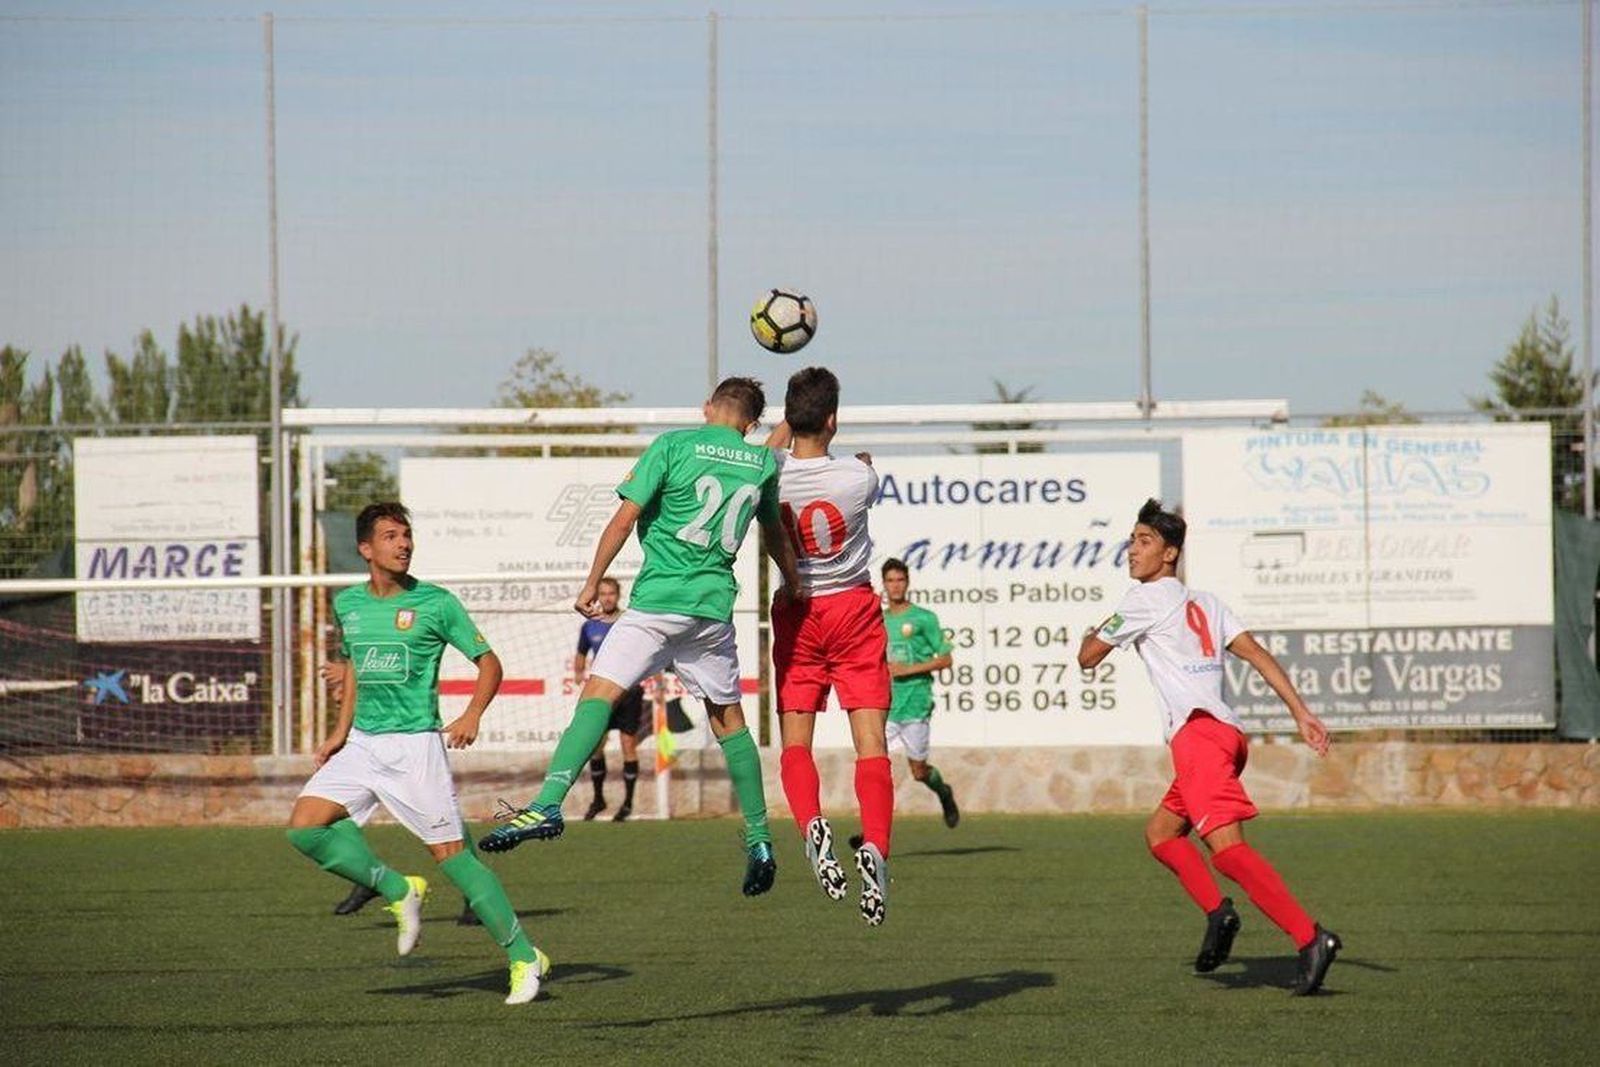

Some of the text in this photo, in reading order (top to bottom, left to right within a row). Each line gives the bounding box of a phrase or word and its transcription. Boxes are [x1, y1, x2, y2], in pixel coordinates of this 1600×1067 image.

[876, 473, 1087, 505] Autocares
[676, 475, 762, 554] 20
[898, 519, 1130, 570] armuñ
[88, 543, 247, 579] MARCE
[461, 585, 493, 601] 923
[499, 584, 532, 601] 200
[898, 582, 1104, 605] manos Pablos
[989, 626, 1022, 648] 12
[1033, 625, 1069, 647] 04
[1186, 601, 1215, 657] 9
[1252, 629, 1513, 656] AR RESTAURANTE
[985, 663, 1021, 686] 00
[1033, 663, 1068, 685] 77
[1081, 663, 1116, 685] 92
[1223, 655, 1503, 702] Veta de Vargas
[985, 690, 1021, 712] 96
[1033, 689, 1068, 711] 04
[1081, 689, 1116, 711] 95
